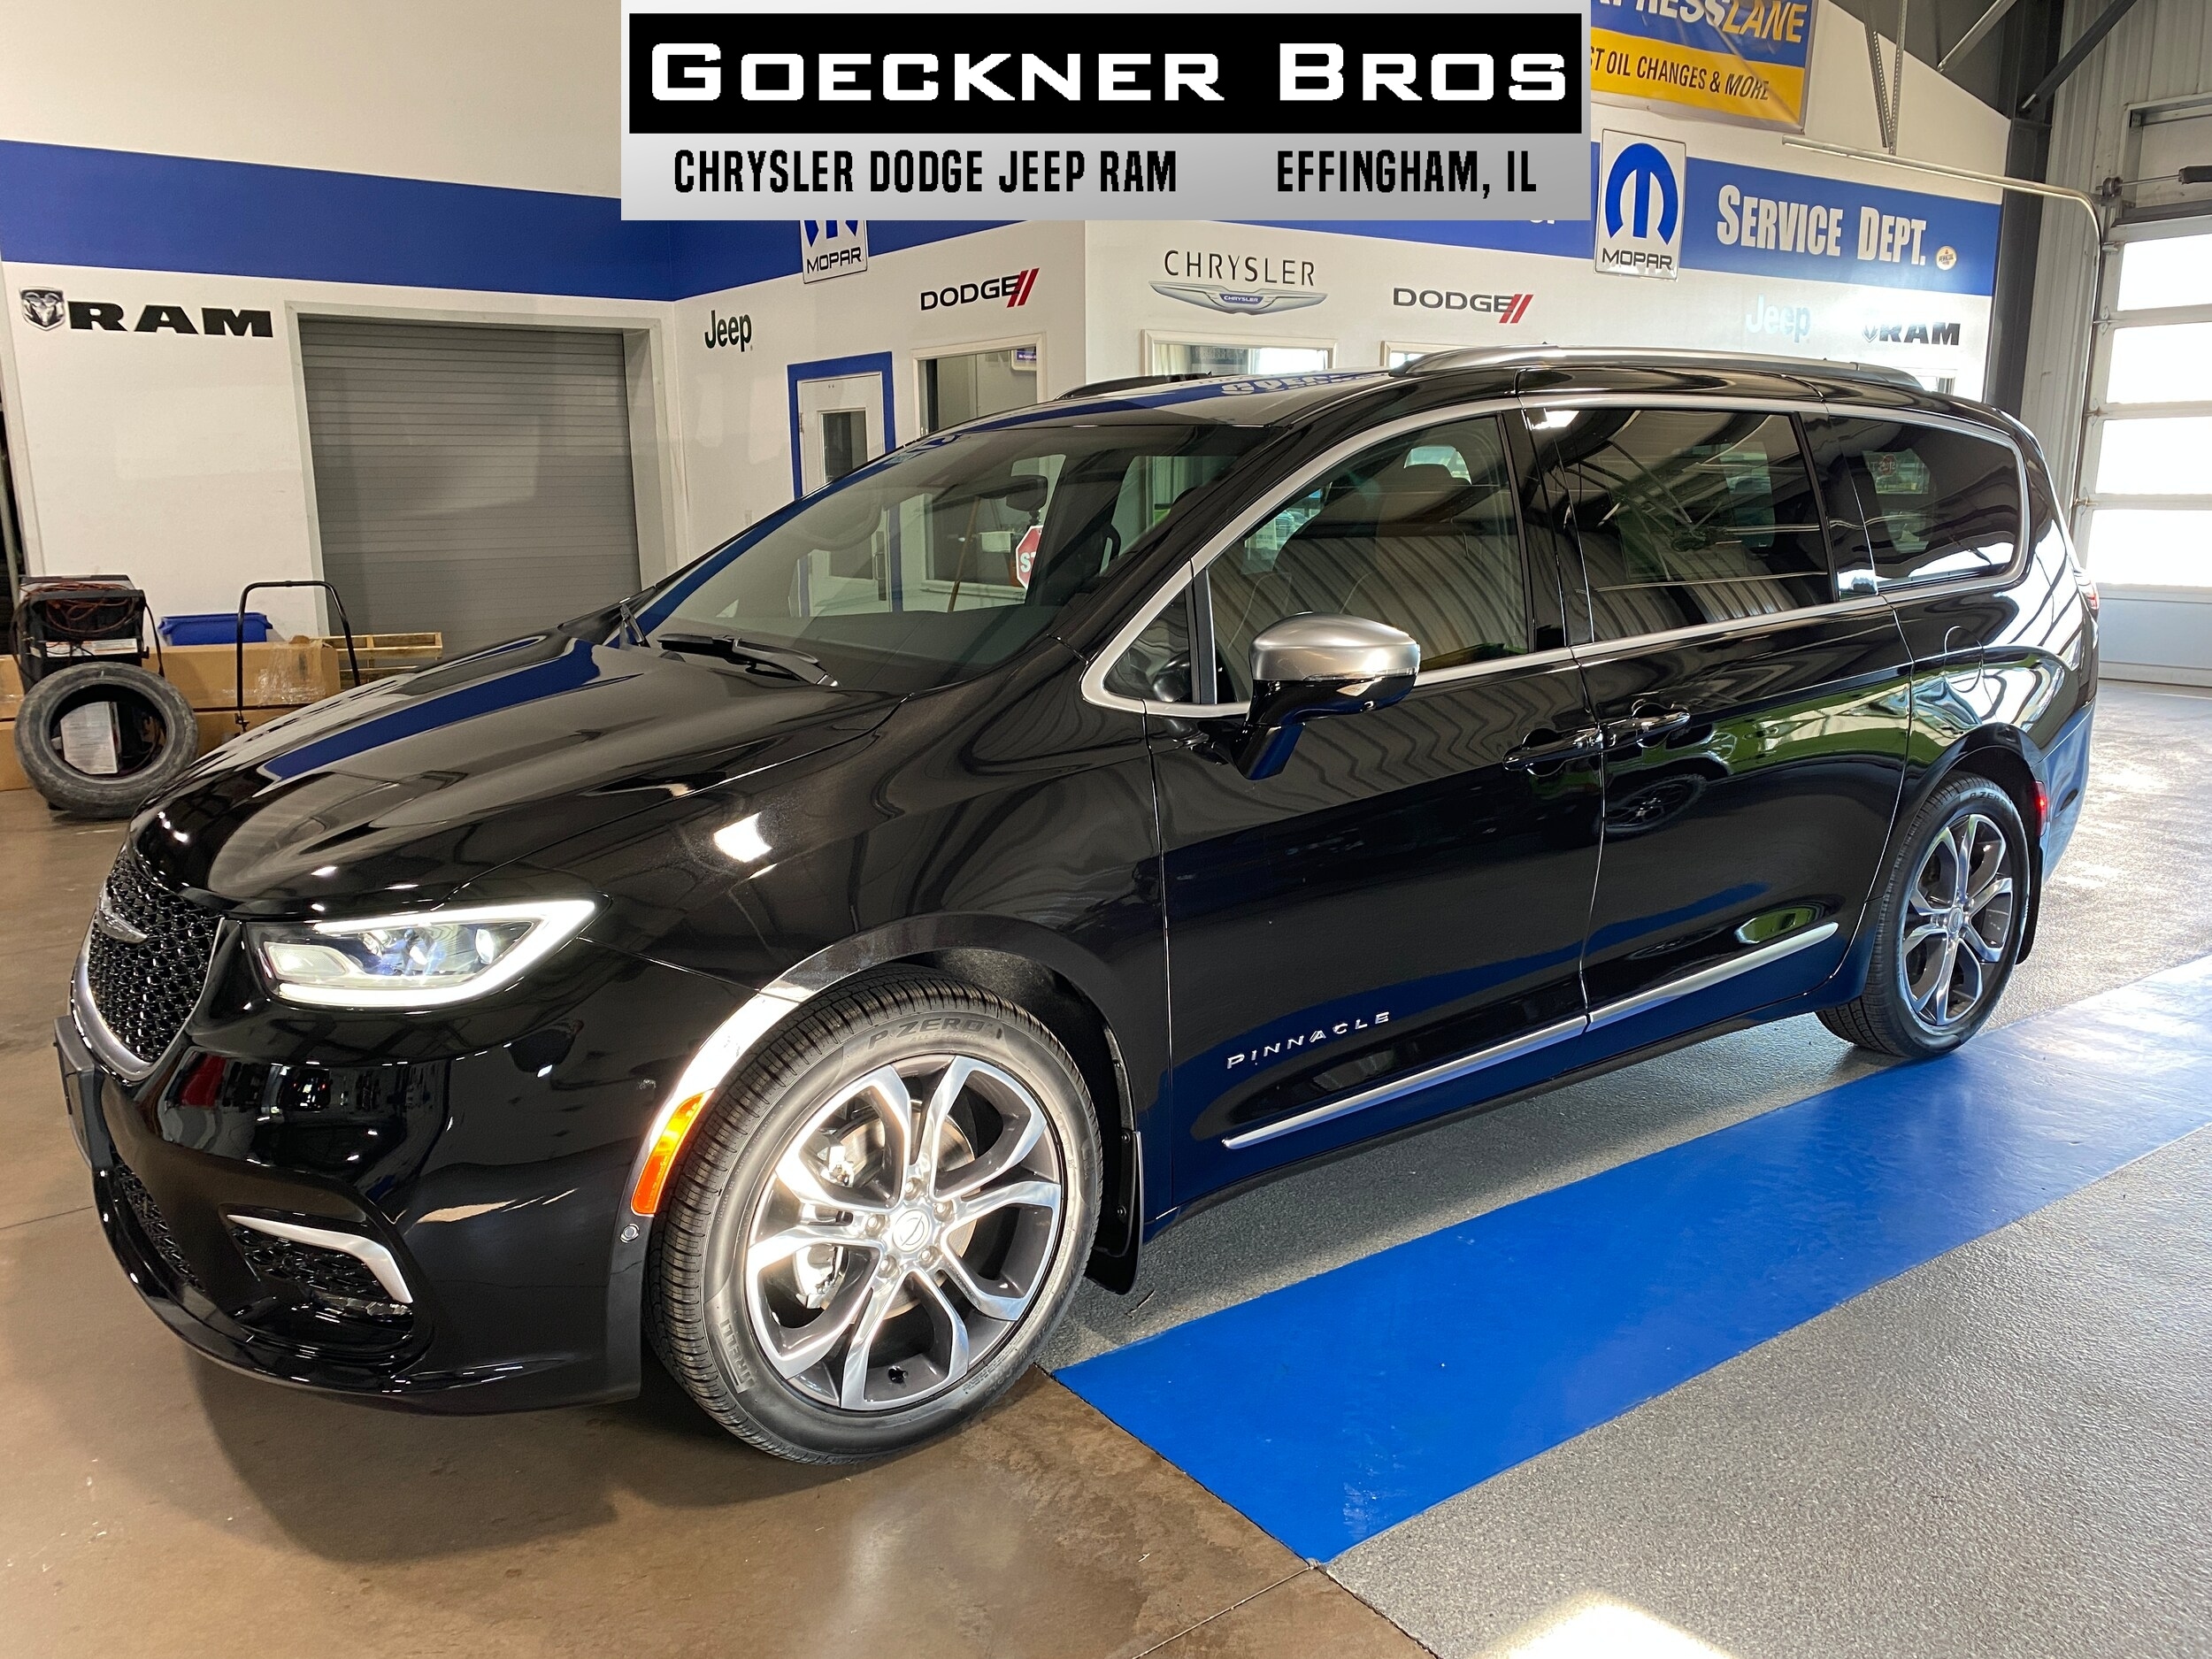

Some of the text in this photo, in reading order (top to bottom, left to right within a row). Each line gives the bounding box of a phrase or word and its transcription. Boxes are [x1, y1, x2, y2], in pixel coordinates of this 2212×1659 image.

[1607, 51, 1631, 77] OIL
[1637, 56, 1707, 89] CHANGES
[1709, 71, 1721, 93] &
[1724, 73, 1770, 101] MORE
[1717, 184, 1843, 257] SERVICE
[806, 246, 862, 274] MOPAR
[1164, 250, 1316, 286] CHRYSLER
[1601, 247, 1672, 271] MOPAR
[920, 274, 1020, 311] DODGE
[1393, 287, 1515, 314] DODGE
[66, 300, 273, 338] RAM
[704, 310, 752, 352] Jeep
[1745, 293, 1811, 343] Jeep
[1878, 321, 1961, 346] RAM
[867, 1029, 889, 1050] P
[1226, 1011, 1390, 1070] PINNACLE
